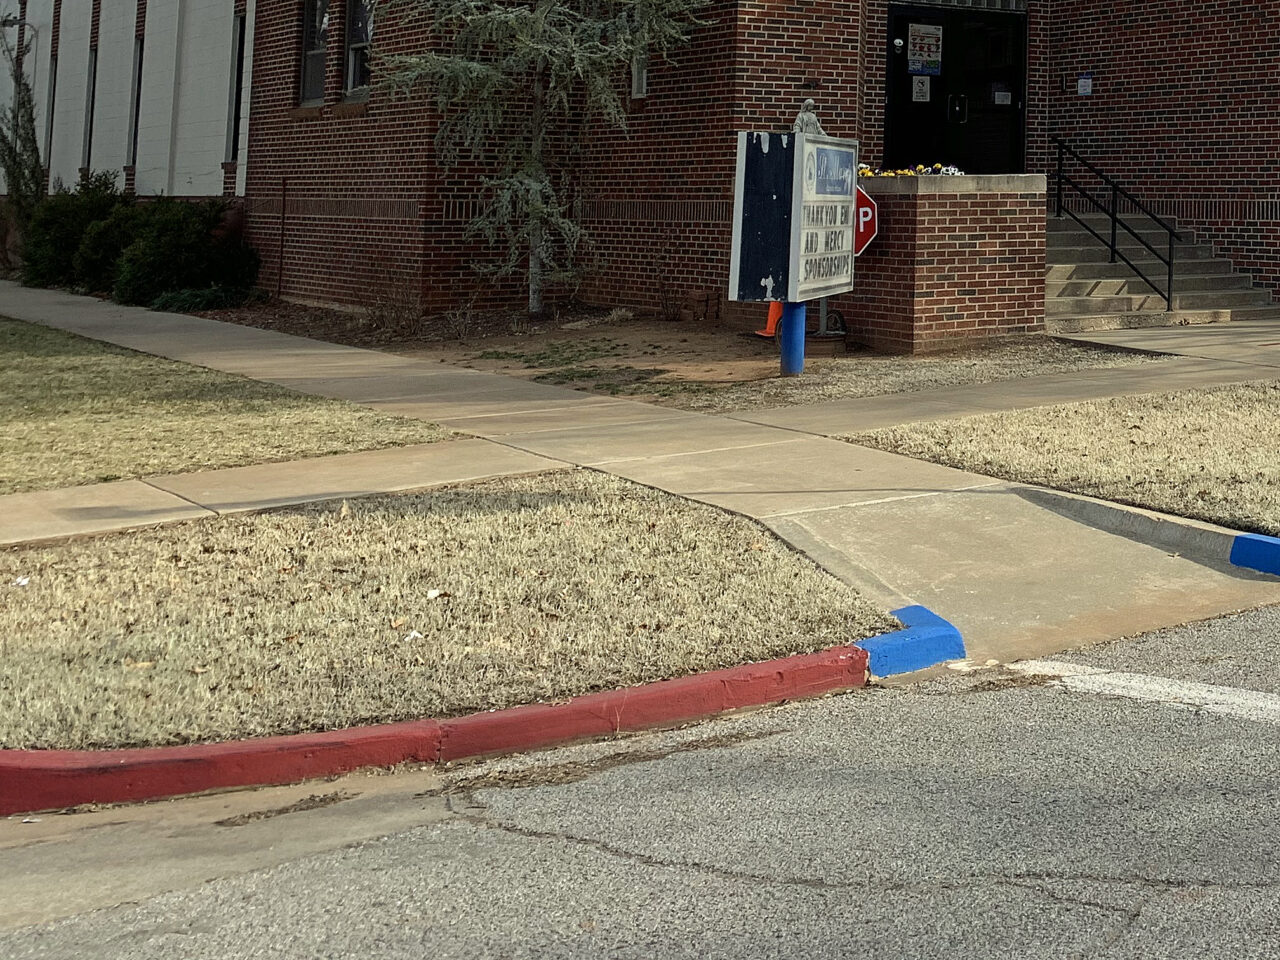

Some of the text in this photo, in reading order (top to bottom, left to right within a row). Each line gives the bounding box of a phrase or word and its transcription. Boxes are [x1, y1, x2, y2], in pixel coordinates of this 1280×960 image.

[804, 229, 845, 254] AND MERCY
[803, 254, 850, 281] SPONSORSHIPS
